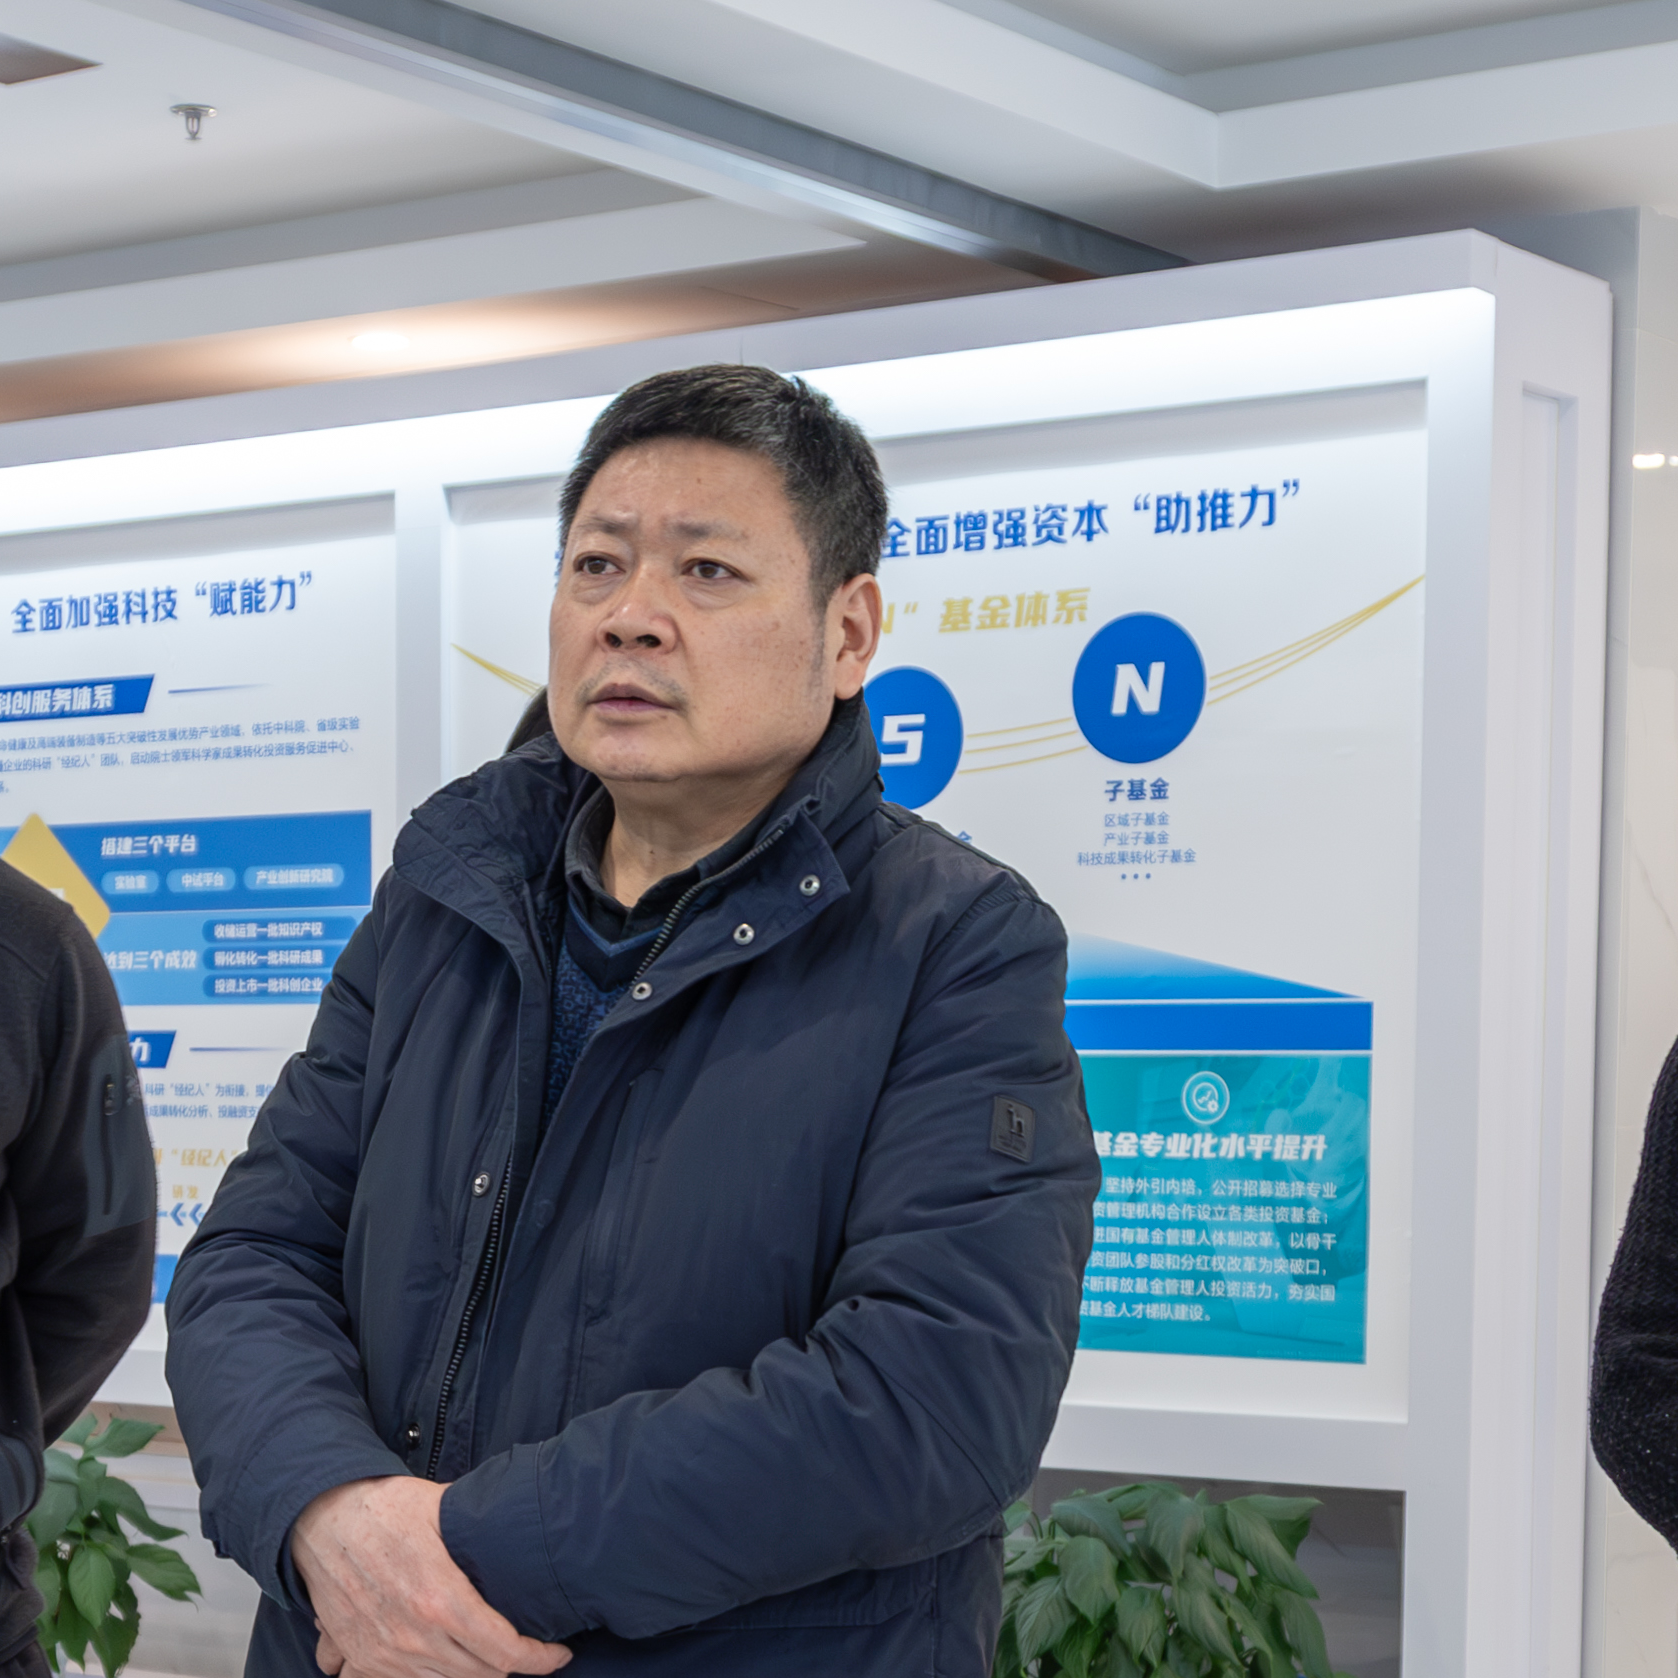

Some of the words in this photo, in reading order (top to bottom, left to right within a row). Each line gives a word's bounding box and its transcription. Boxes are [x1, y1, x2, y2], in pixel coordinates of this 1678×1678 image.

[1110, 661, 1165, 717] N
[880, 714, 926, 765] S
[1104, 777, 1170, 803] 子基金
[1104, 811, 1169, 828] 区域子基金
[101, 834, 198, 857] 搭建三个平台
[1103, 830, 1169, 847] 产业子基金
[1076, 848, 1197, 867] 科技成果转化子基金
[115, 873, 147, 890] 实验室
[181, 872, 225, 888] 中试平台
[256, 868, 334, 886] 产业创新研究院
[1093, 1131, 1328, 1161] 基金专业化水平提升
[1085, 1251, 1329, 1277] 资团队参股和分红权改革为突破口，
